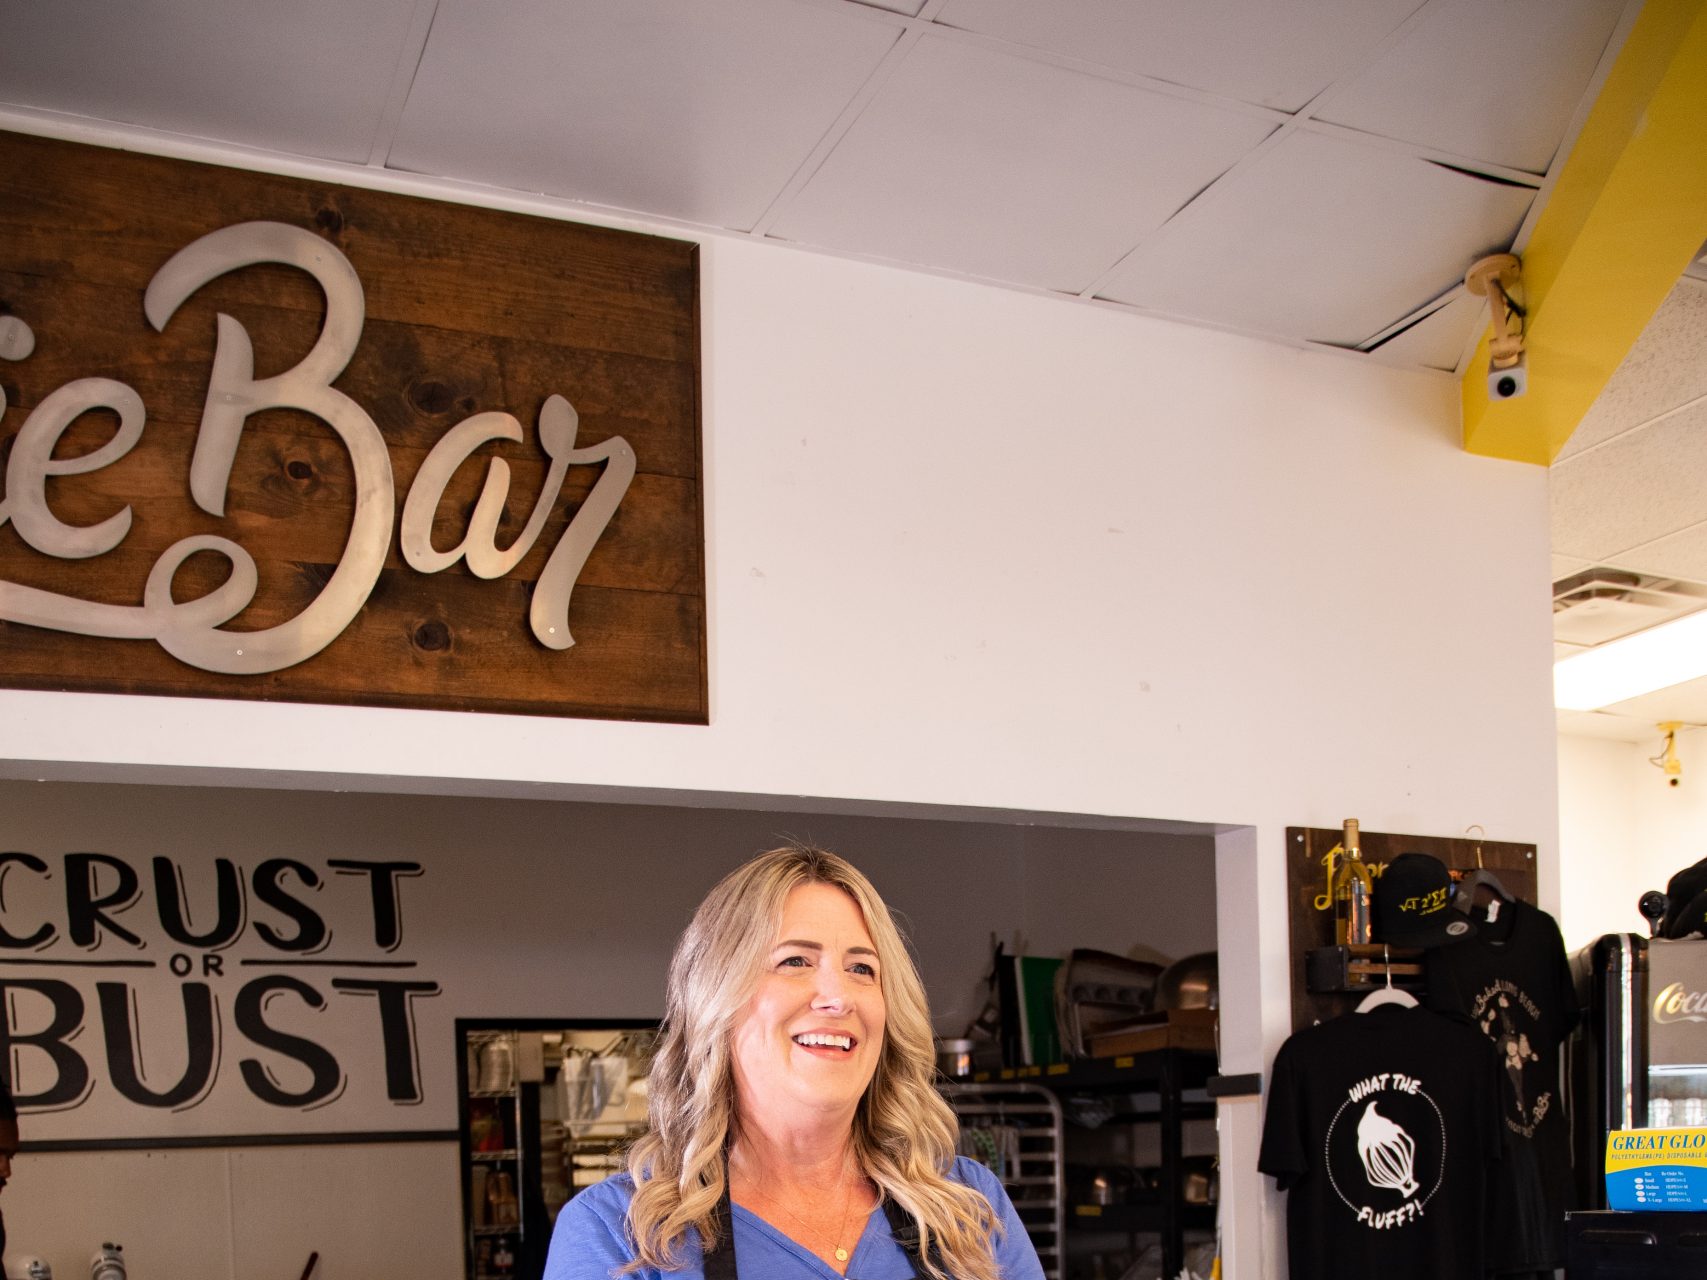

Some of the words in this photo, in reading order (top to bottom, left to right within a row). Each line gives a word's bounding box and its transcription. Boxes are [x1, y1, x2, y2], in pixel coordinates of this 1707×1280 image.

[0, 852, 425, 953] CRUST
[169, 953, 224, 977] OR
[0, 974, 442, 1113] BUST
[1349, 1073, 1390, 1102] WHAT
[1393, 1073, 1422, 1094] THE
[1613, 1136, 1667, 1150] GREAT
